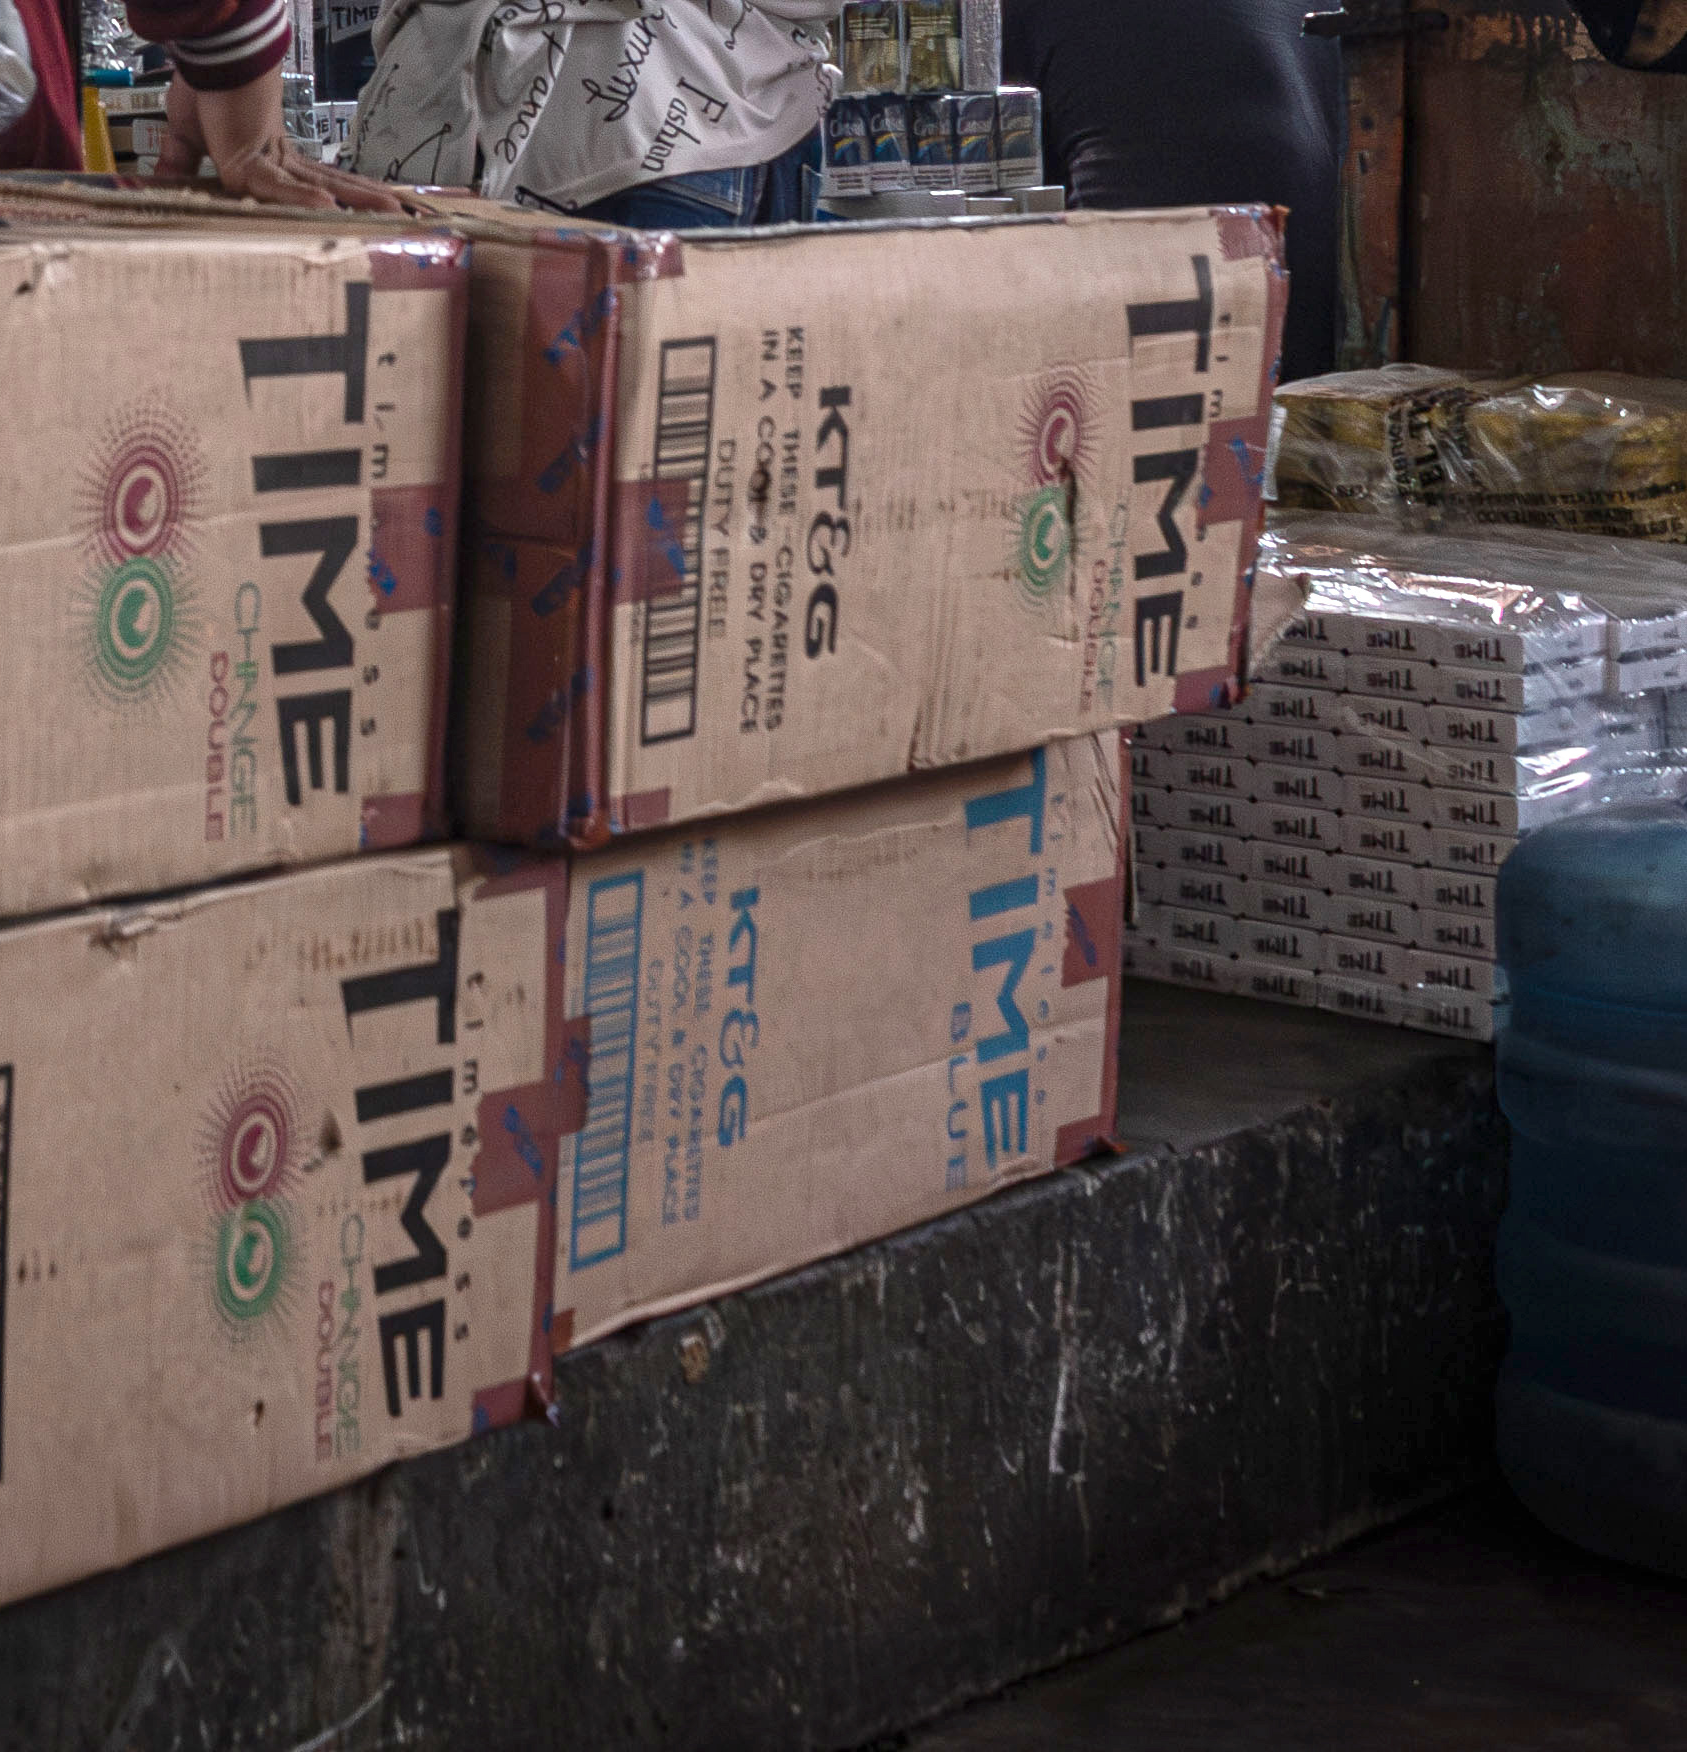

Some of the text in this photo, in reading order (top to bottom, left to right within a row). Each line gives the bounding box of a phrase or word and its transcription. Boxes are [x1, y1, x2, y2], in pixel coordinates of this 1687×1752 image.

[641, 73, 730, 175] Fashion
[238, 280, 373, 809] TIME
[707, 439, 739, 641] DUTY FREE
[766, 325, 807, 732] KEEP THESE CIGARETTES
[803, 384, 854, 661] KT&G
[1125, 252, 1215, 689] TIME
[740, 562, 770, 735] DRY PLACE
[1367, 624, 1416, 650] TIME
[1455, 639, 1505, 662] TIME
[1456, 678, 1505, 702] TIME
[201, 649, 229, 843] DOUBLE
[1274, 777, 1321, 799] TIME
[1361, 789, 1408, 813] TIME
[1448, 717, 1499, 742] TIME
[1449, 801, 1499, 827] TIME
[962, 749, 1046, 1169] TIME
[1348, 910, 1394, 933] TIME
[1349, 870, 1396, 892] TIME
[1437, 883, 1483, 909] TIME
[717, 886, 760, 1148] KT&G
[945, 1003, 972, 1192] BLUE
[338, 908, 458, 1419] TIME
[313, 1280, 335, 1464] DOUBLE
